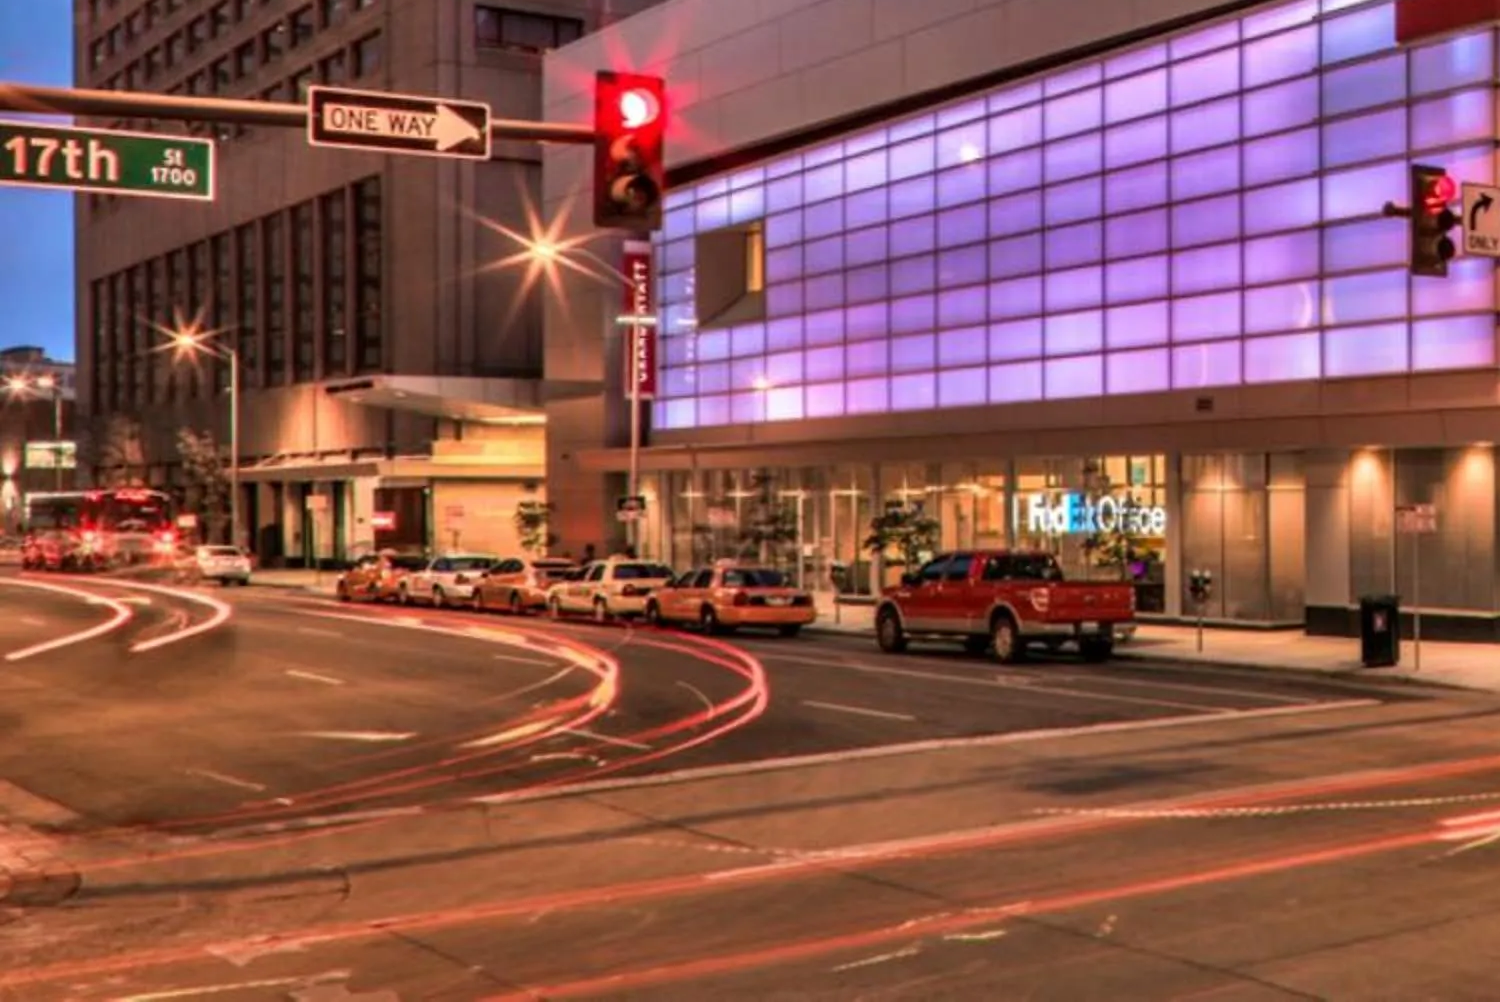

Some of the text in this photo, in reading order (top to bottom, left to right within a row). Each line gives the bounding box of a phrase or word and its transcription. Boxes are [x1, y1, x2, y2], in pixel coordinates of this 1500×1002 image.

[330, 107, 436, 136] ONE WAY
[5, 135, 183, 182] 17th St
[151, 166, 196, 186] 1700
[1469, 235, 1499, 250] ONLY
[1097, 494, 1166, 534] Ofce
